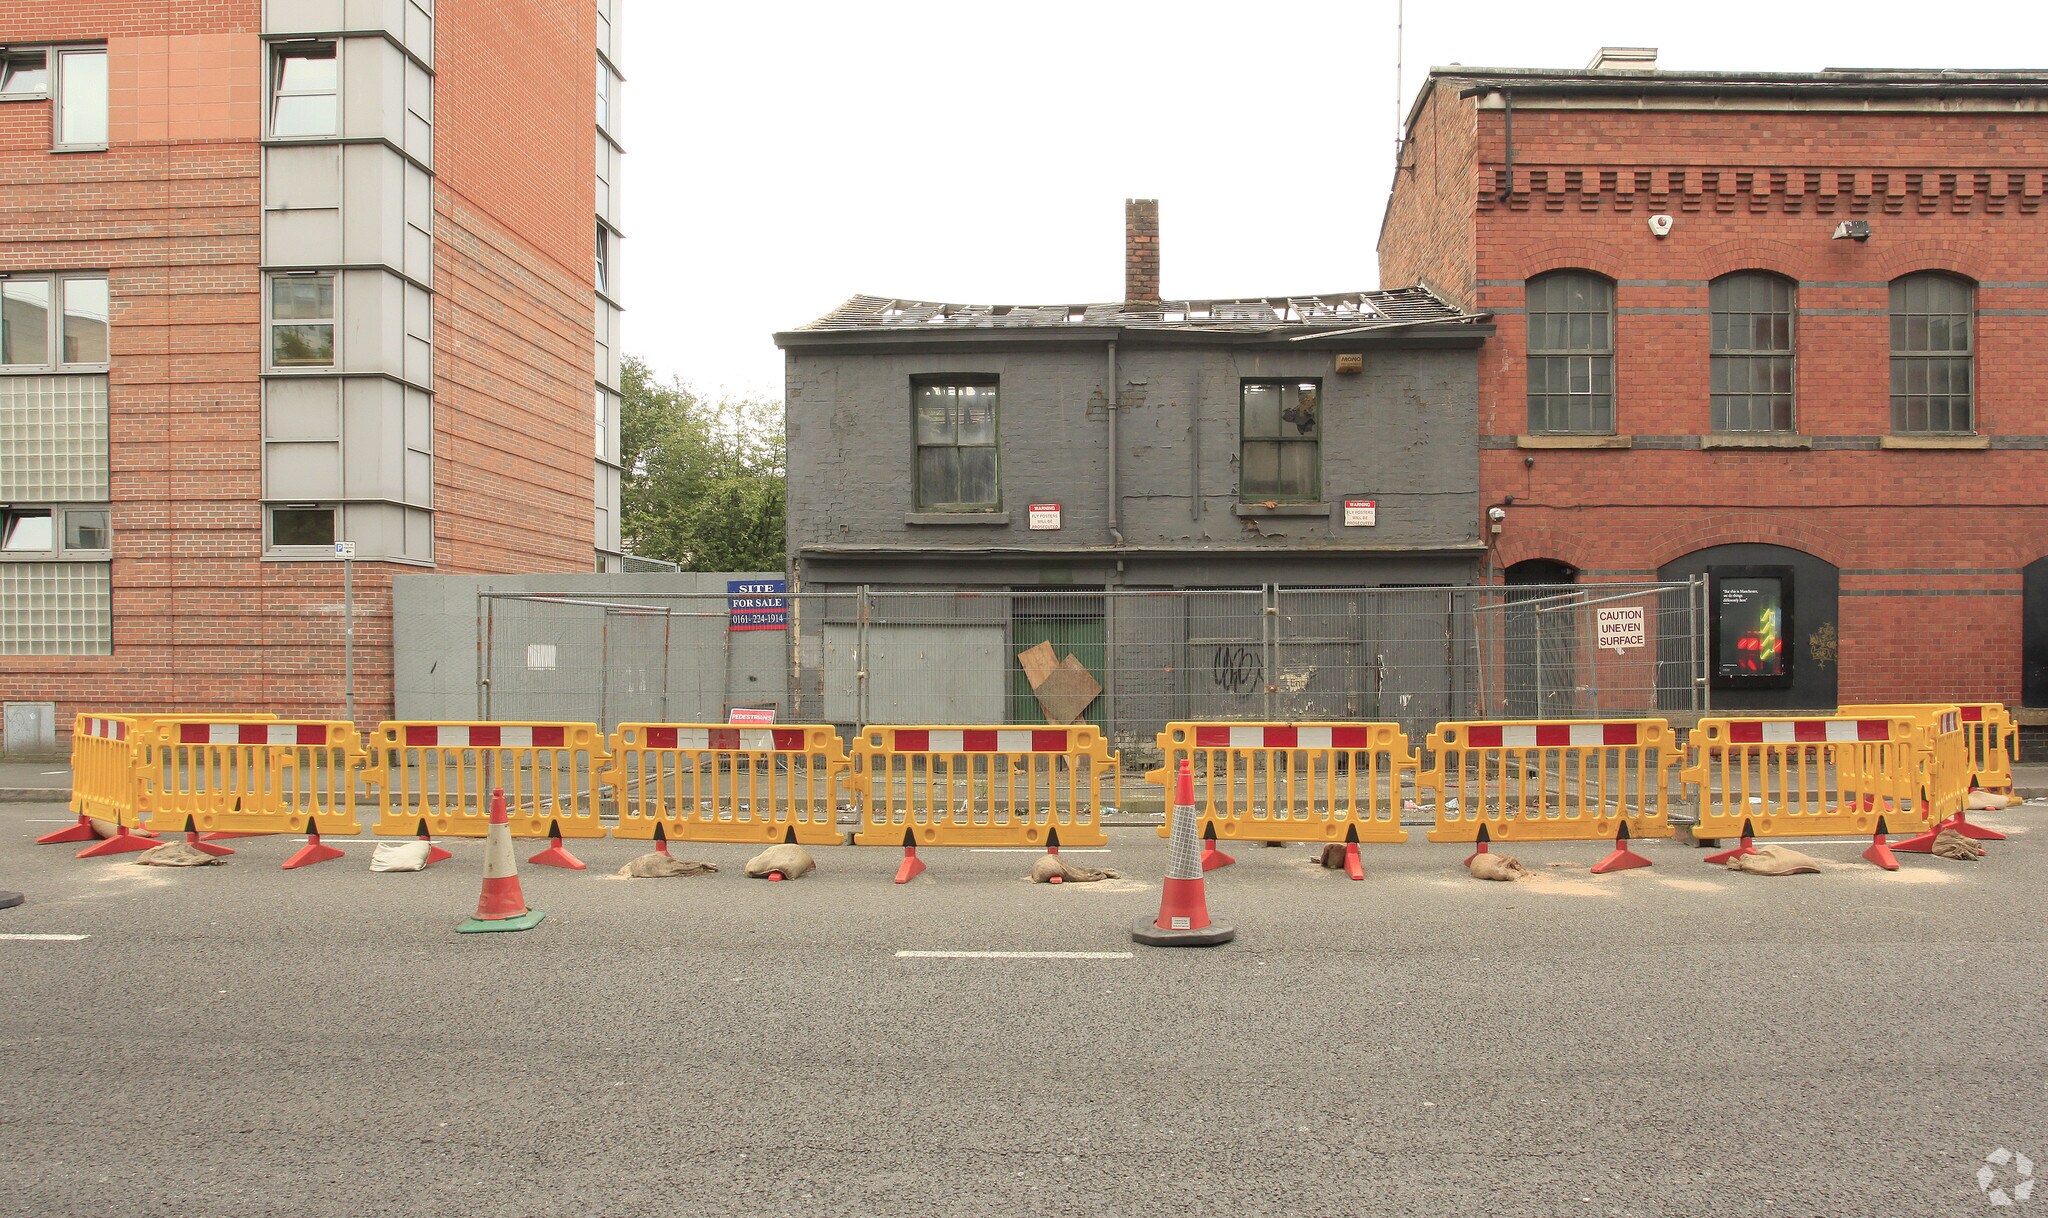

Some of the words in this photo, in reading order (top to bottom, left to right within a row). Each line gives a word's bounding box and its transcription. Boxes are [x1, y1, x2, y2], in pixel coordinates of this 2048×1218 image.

[739, 584, 775, 593] SITE
[732, 599, 754, 608] FOR
[755, 598, 783, 607] SALE
[752, 613, 784, 623] 224-1914
[1599, 610, 1642, 621] CAUTION
[1601, 622, 1641, 634] UNEVEN
[1599, 635, 1644, 646] SURFACE
[731, 713, 773, 722] PEDESTRIANS
